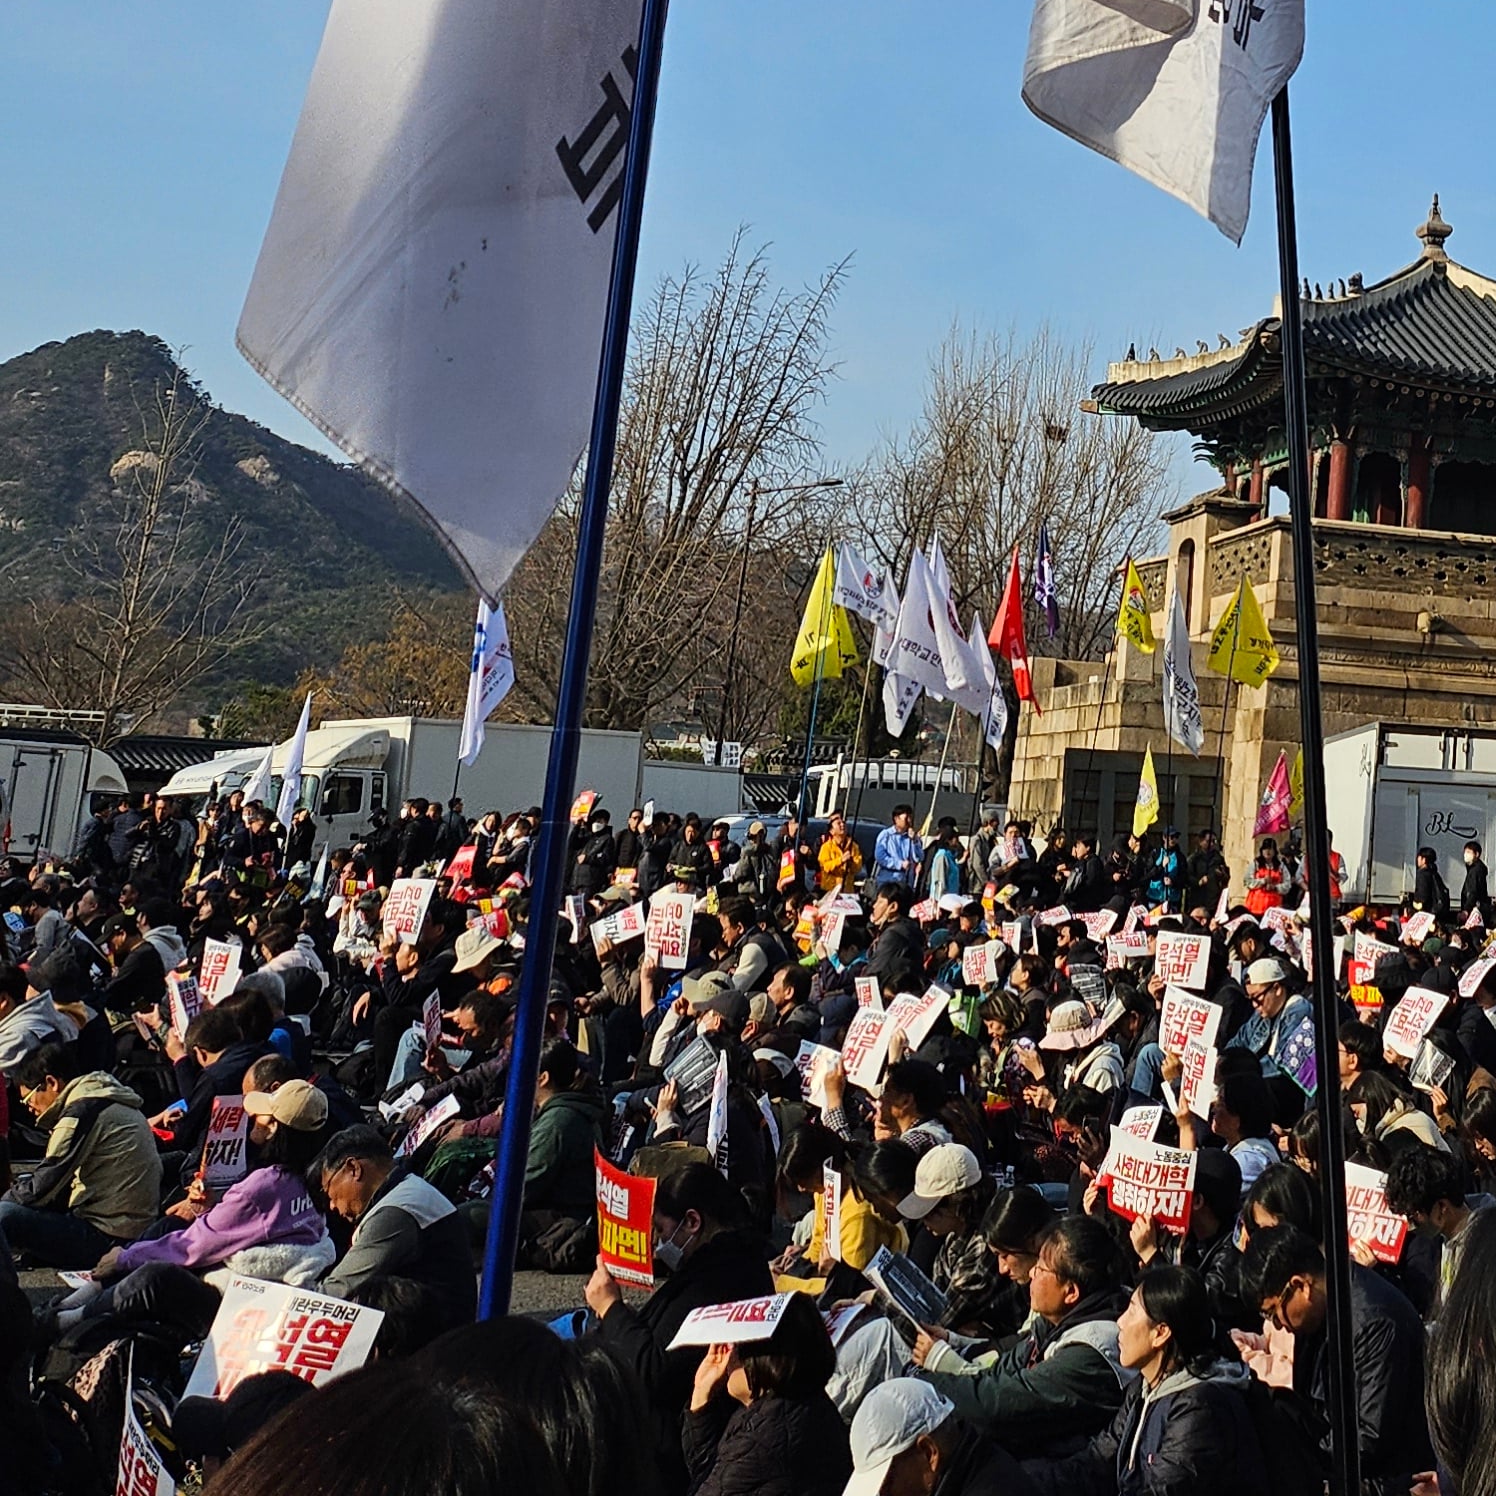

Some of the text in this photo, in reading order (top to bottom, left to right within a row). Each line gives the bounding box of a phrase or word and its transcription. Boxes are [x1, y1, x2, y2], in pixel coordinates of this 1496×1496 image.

[1114, 1152, 1190, 1190] 사회대개혁
[1154, 1150, 1192, 1165] 노동중심
[1111, 1177, 1186, 1219] 쟁취하자!
